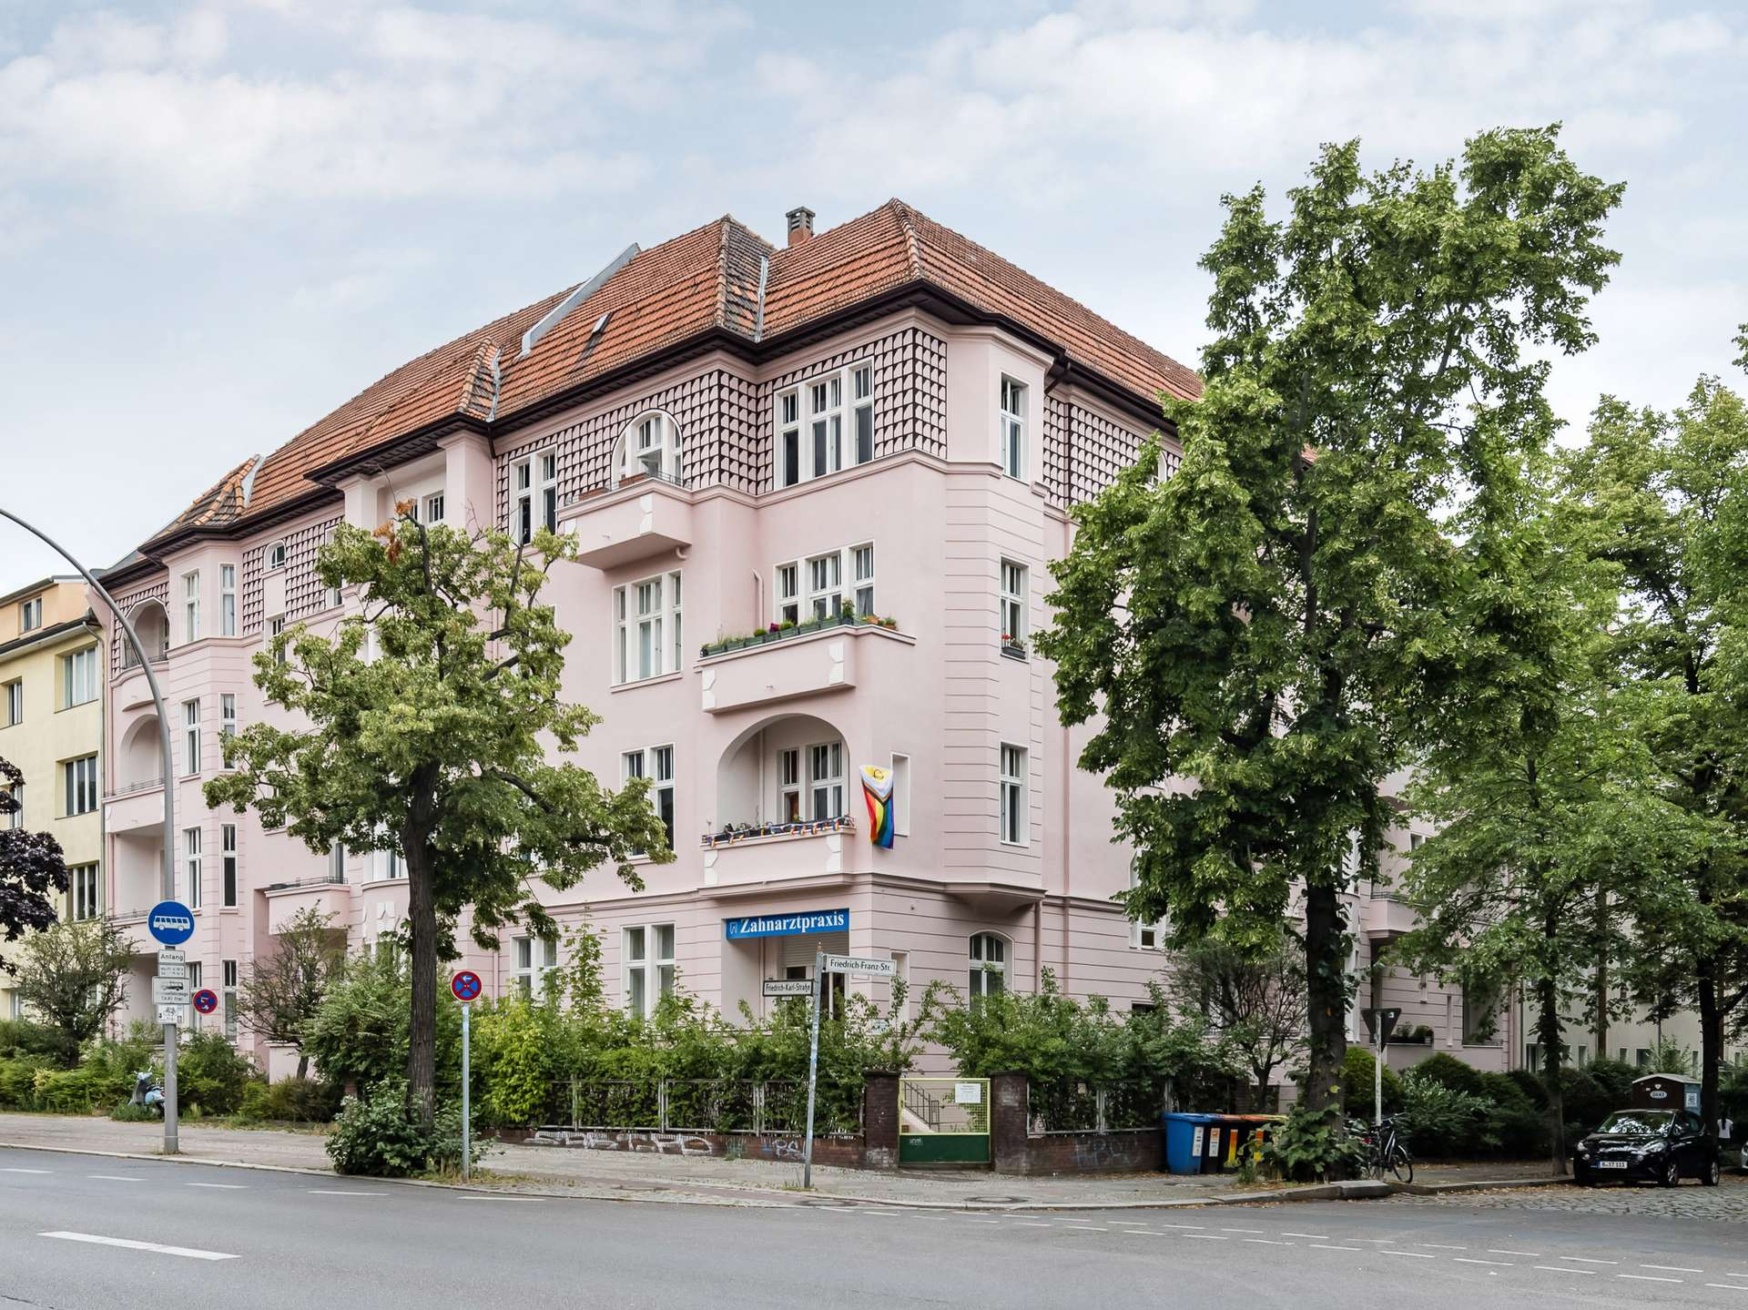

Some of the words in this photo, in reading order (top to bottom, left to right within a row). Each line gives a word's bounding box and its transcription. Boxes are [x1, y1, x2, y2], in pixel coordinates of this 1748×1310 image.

[740, 911, 845, 933] Zahnarztpraxis
[160, 953, 184, 962] Anfang
[830, 959, 891, 971] Friedrich-Franz-Str.
